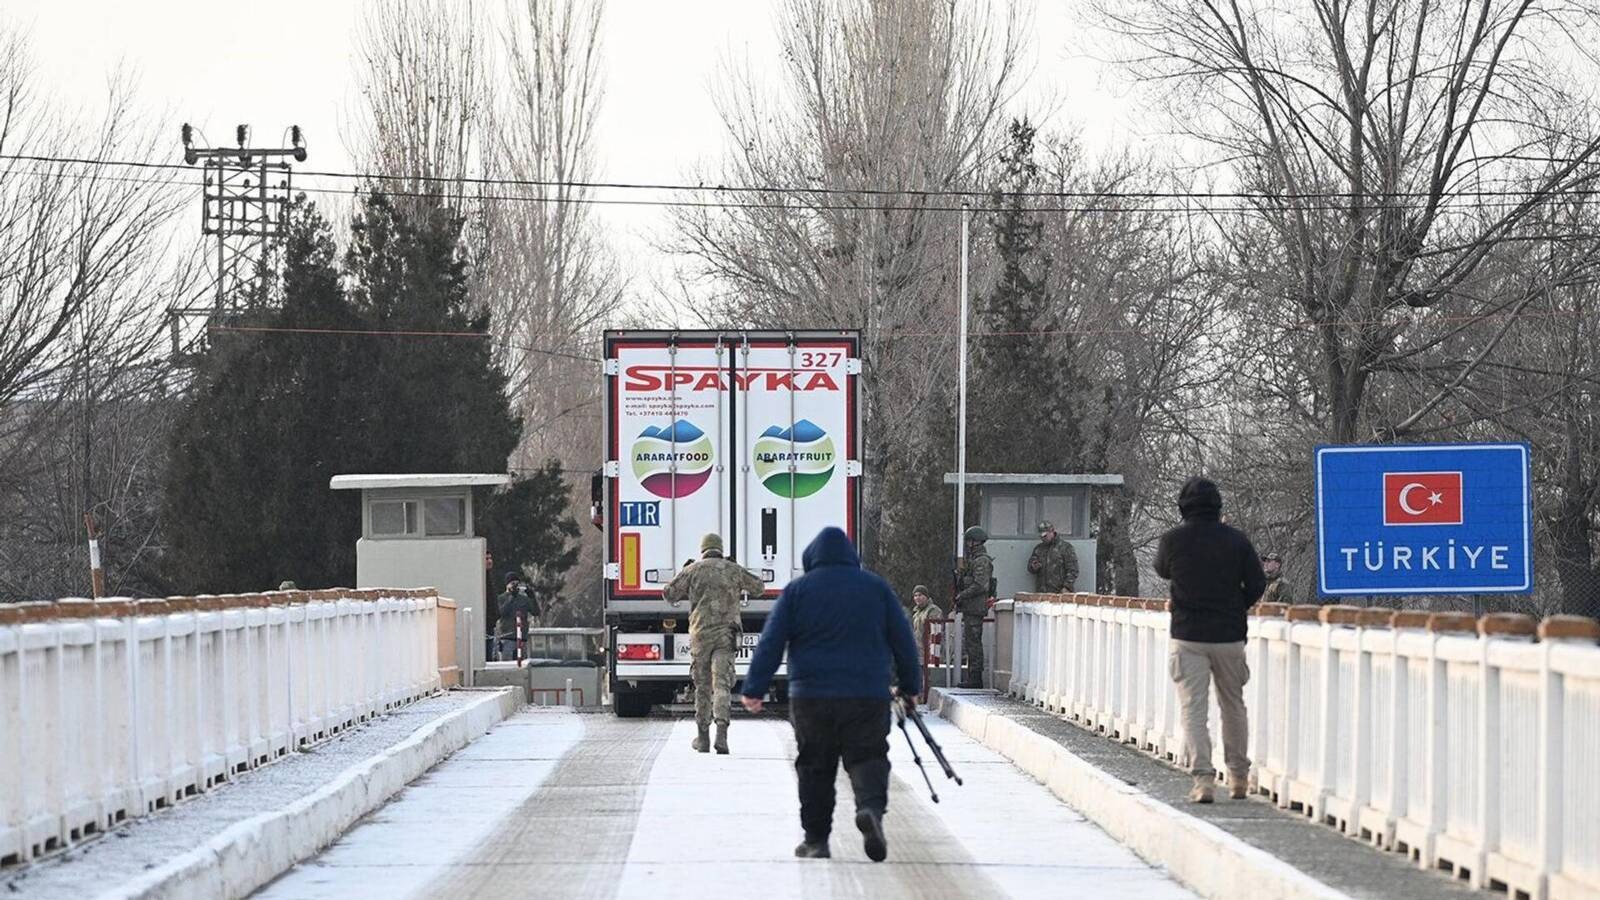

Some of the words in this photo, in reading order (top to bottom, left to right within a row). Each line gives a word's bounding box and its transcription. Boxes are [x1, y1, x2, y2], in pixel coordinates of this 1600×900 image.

[802, 352, 842, 368] 327
[625, 365, 839, 392] SPAYKA
[636, 453, 709, 461] ARARATFOOD
[623, 503, 656, 524] TIR
[1340, 538, 1509, 572] TÜRKİYE
